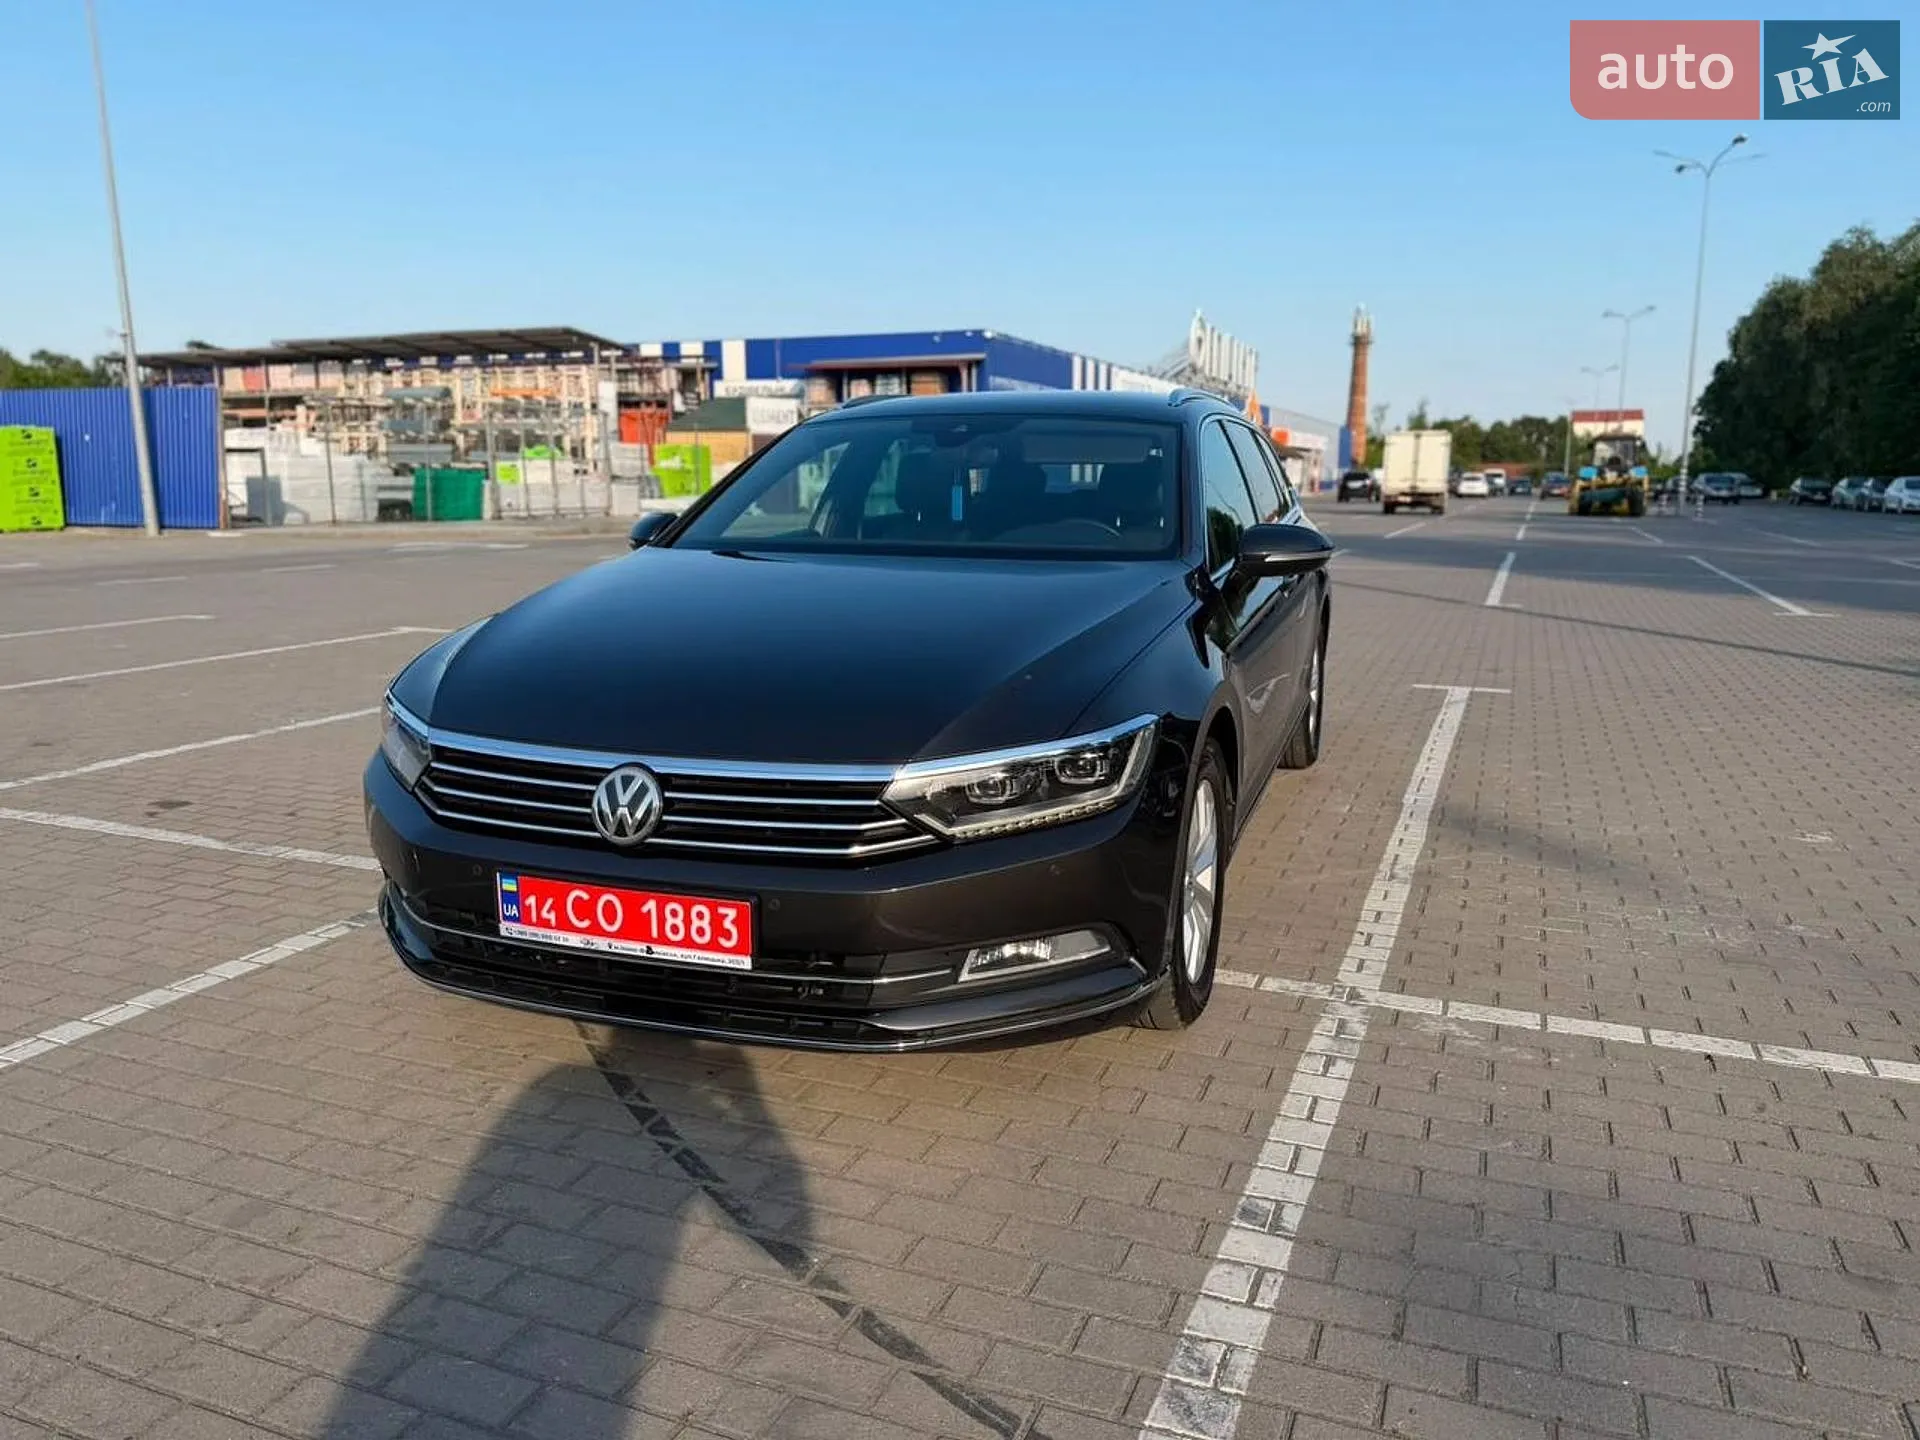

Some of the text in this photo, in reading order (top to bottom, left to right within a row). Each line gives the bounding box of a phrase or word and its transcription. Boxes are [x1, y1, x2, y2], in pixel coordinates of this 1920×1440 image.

[503, 903, 519, 918] UA
[524, 889, 740, 949] 14 CO 1883
